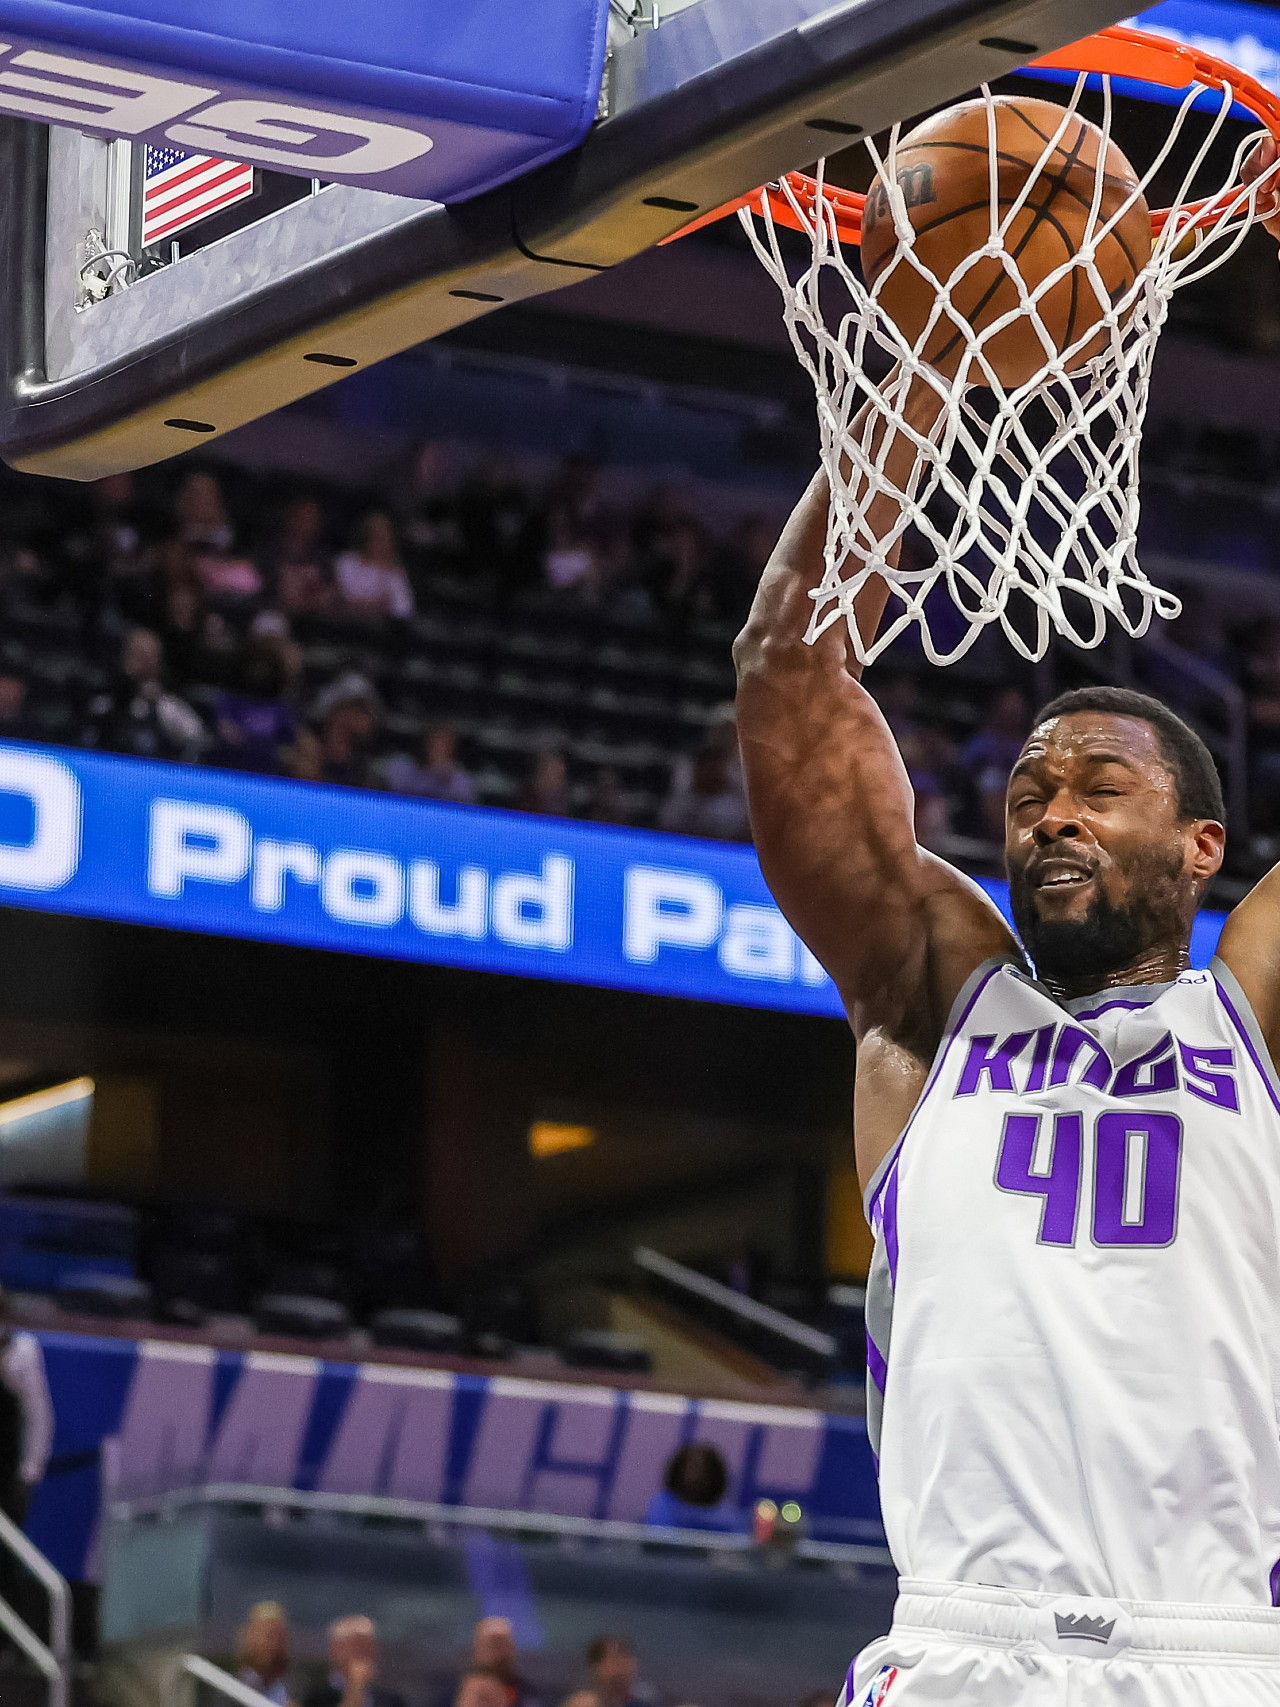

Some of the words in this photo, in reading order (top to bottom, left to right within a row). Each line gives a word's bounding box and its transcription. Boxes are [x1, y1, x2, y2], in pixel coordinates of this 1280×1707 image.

[0, 43, 434, 175] GE
[148, 798, 575, 950] Proud
[952, 1022, 1241, 1115] KINGS
[993, 1109, 1184, 1249] 40
